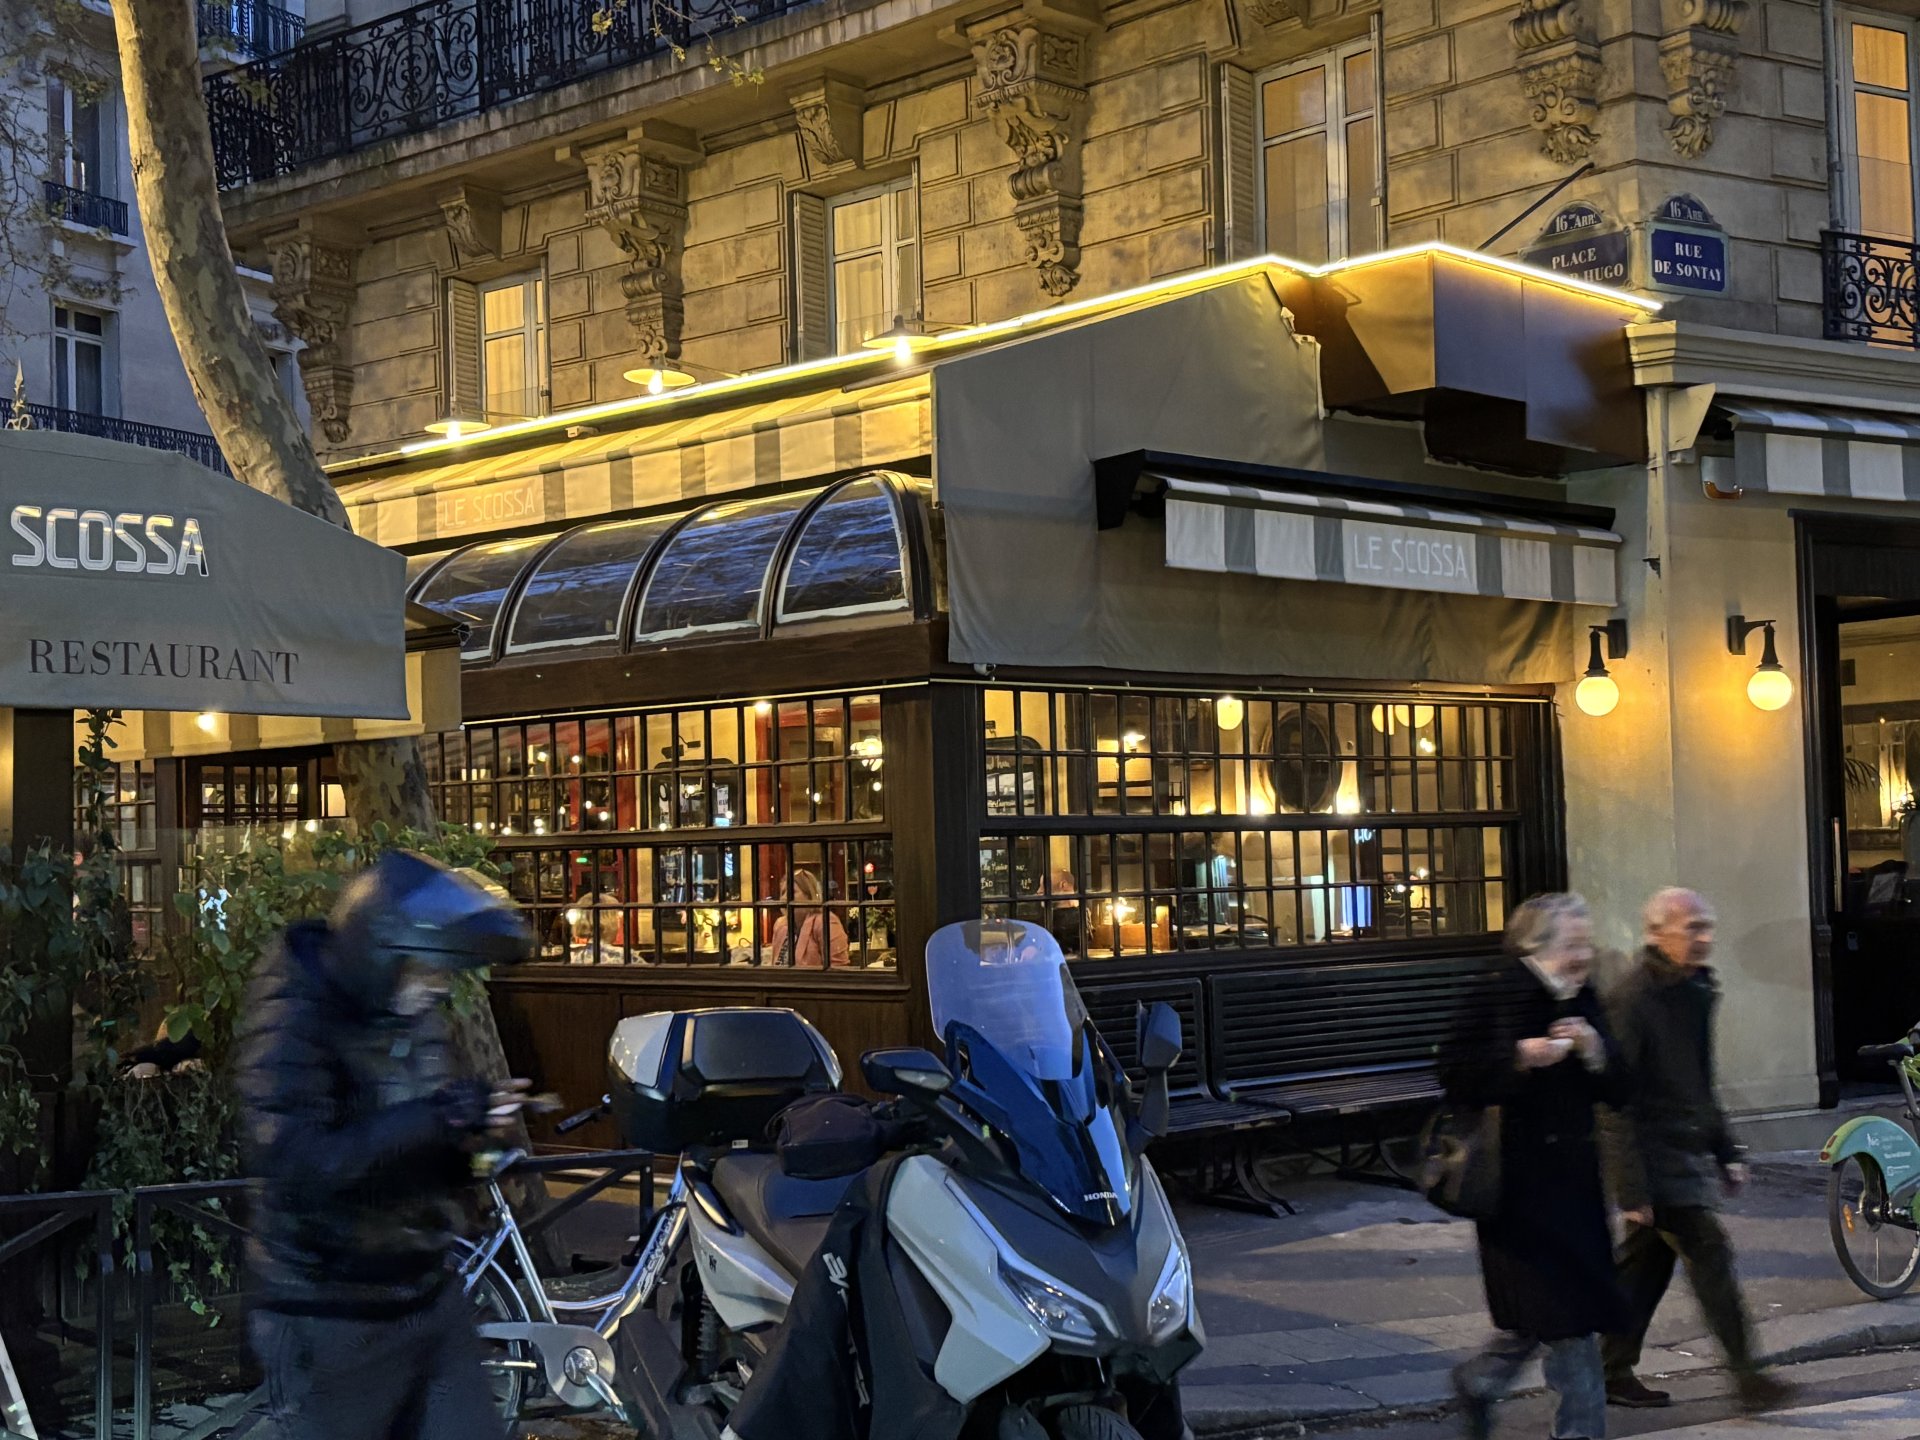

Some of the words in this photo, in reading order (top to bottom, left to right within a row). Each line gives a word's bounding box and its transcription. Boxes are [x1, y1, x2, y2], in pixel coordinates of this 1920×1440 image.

[1552, 247, 1598, 270] PLACE
[1675, 242, 1702, 259] RUE
[1583, 262, 1625, 283] HUGO
[1654, 259, 1672, 275] DE
[1676, 262, 1722, 282] SONTAY
[442, 504, 466, 527] LE
[472, 488, 536, 523] SCOSSA
[10, 504, 209, 577] SCOSSA
[1353, 533, 1384, 570] LE
[1392, 538, 1468, 579] SCOSSA
[29, 638, 299, 684] RESTAURANT
[1083, 1191, 1118, 1202] HONDA
